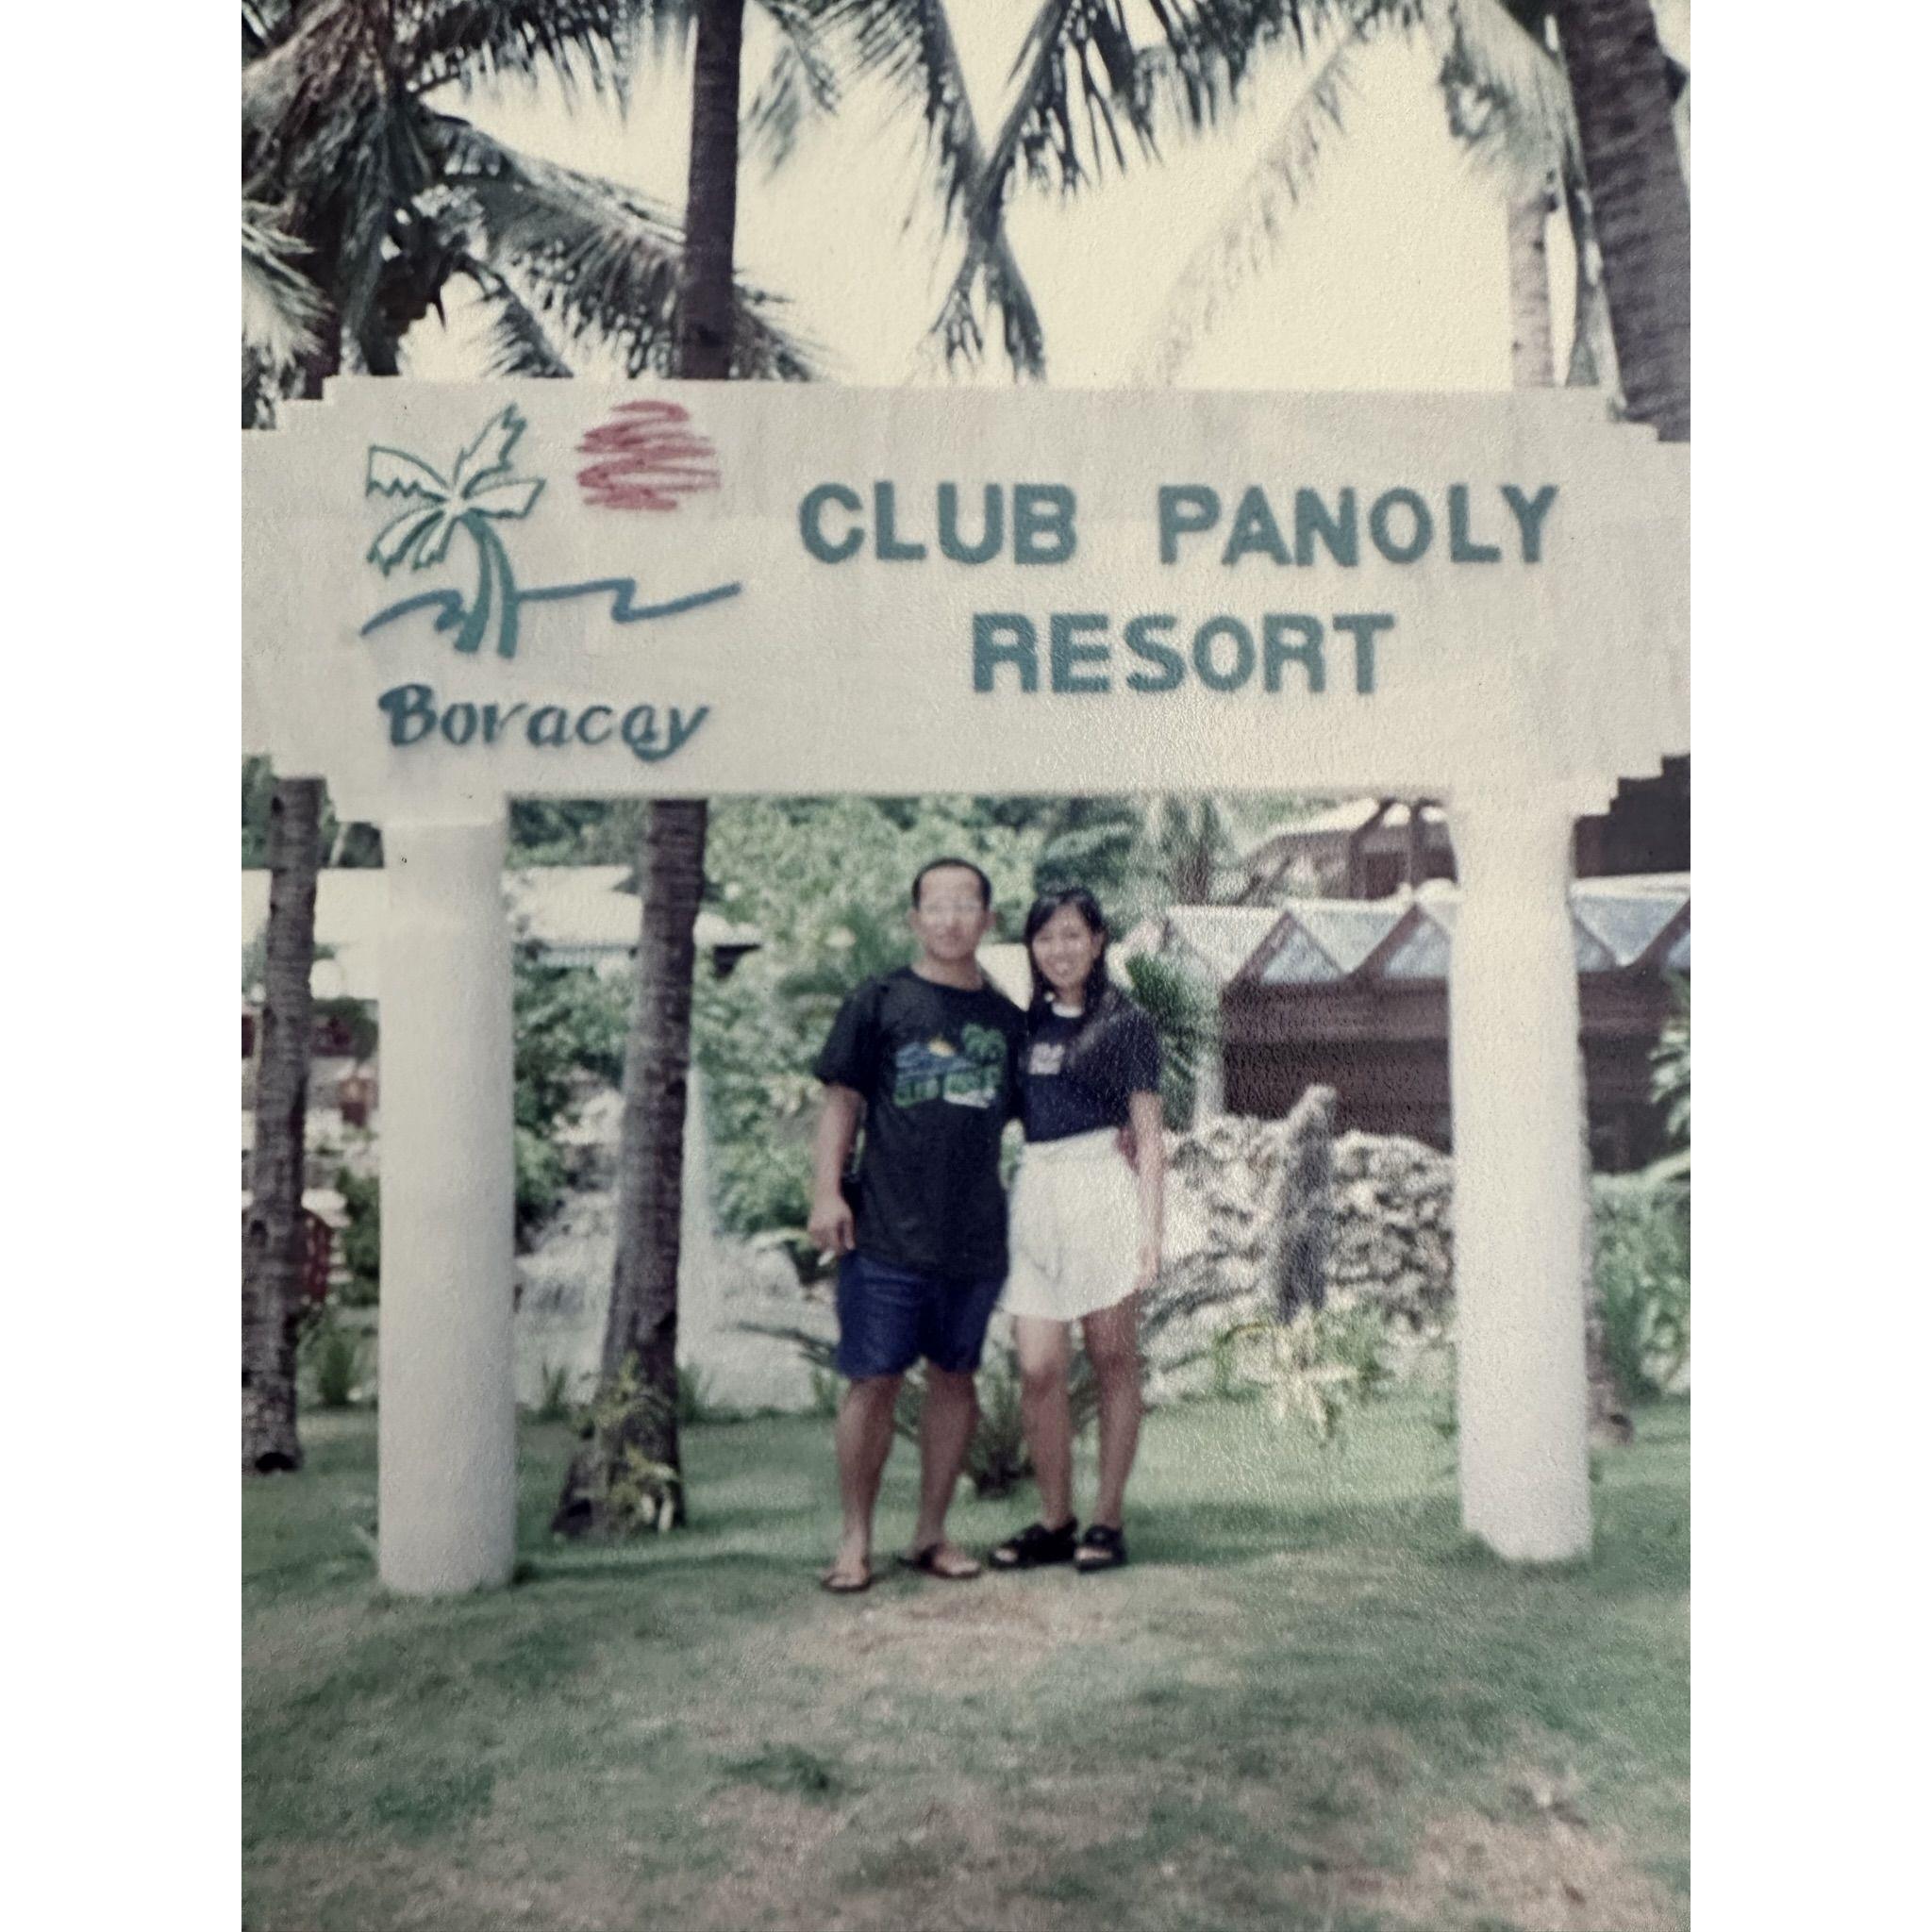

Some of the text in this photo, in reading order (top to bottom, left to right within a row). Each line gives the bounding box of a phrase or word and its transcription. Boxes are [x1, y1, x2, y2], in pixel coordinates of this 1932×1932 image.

[799, 482, 1560, 567] CLUB PANOLY
[972, 612, 1395, 695] RESORT
[377, 683, 711, 762] Boracay
